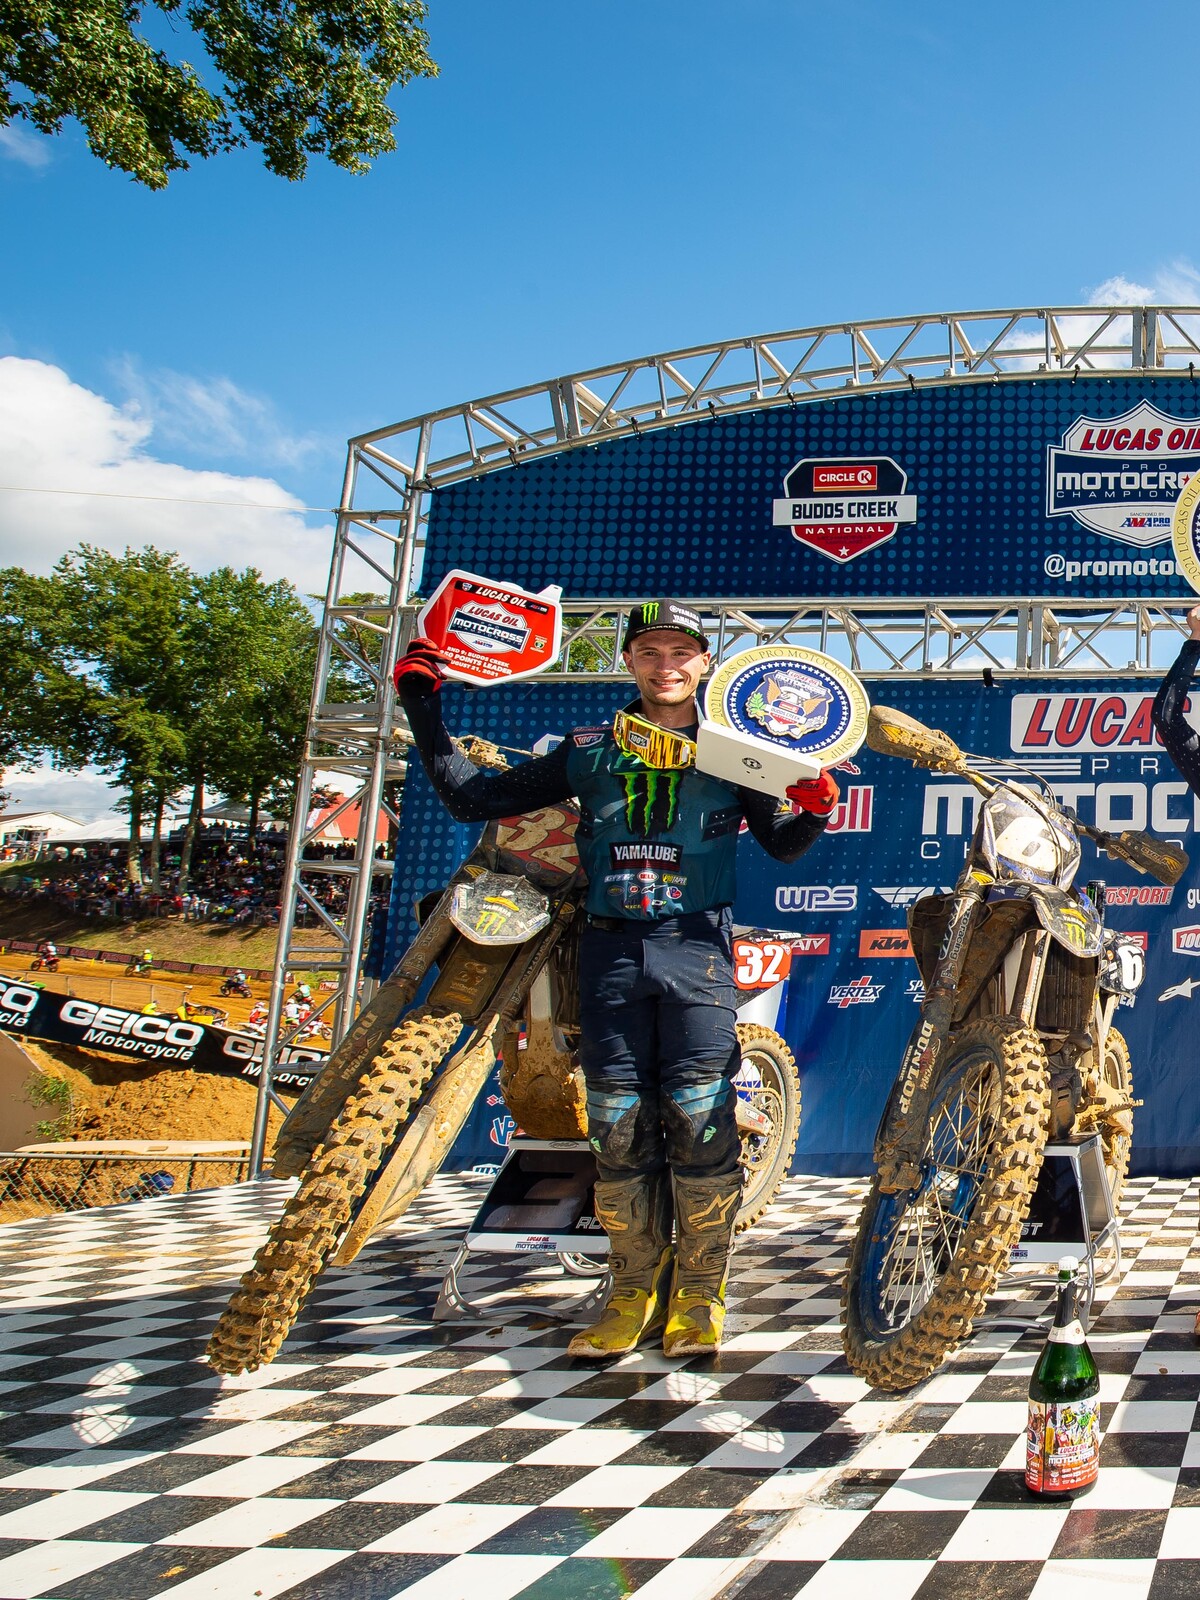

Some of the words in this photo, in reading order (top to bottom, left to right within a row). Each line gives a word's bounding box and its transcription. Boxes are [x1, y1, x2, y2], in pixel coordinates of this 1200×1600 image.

[1079, 428, 1163, 451] LUCAS
[818, 473, 855, 483] CIRCLE
[857, 469, 872, 484] K
[1122, 463, 1168, 471] PRO
[791, 502, 844, 520] BUDDS
[847, 501, 898, 518] CREEK
[1176, 509, 1189, 552] LUCAS
[1185, 488, 1200, 507] OIL
[805, 526, 885, 535] NATIONAL
[1119, 517, 1153, 528] AMA
[475, 586, 511, 604] LUCAS
[509, 595, 527, 609] OIL
[467, 606, 502, 622] LUCAS
[501, 616, 519, 628] OIL
[453, 617, 525, 644] MOTOCROSS
[450, 659, 471, 669] UGUST
[454, 653, 482, 667] POINTS
[483, 661, 513, 676] LEADER
[467, 652, 490, 662] BUDDS
[489, 658, 510, 668] CREEK
[737, 654, 758, 672] OIL
[758, 648, 784, 659] PRO
[712, 663, 738, 693] LUCAS
[787, 649, 853, 690] MOTOCROSS
[711, 693, 723, 721] 2021
[831, 686, 868, 760] CHAMPIONSHIP
[629, 733, 649, 747] 100%
[613, 844, 678, 863] YAMALUBE
[775, 885, 859, 912] WPS
[869, 936, 909, 950] KTM
[737, 944, 784, 985] 32
[830, 985, 886, 998] VERTEX
[60, 1000, 204, 1047] GEICO
[82, 1028, 197, 1062] Motorcycle
[899, 1019, 935, 1115] DUNLOP
[492, 1115, 518, 1145] VP
[515, 1242, 558, 1250] MOTOCROSS
[1058, 1446, 1080, 1454] LUCAS
